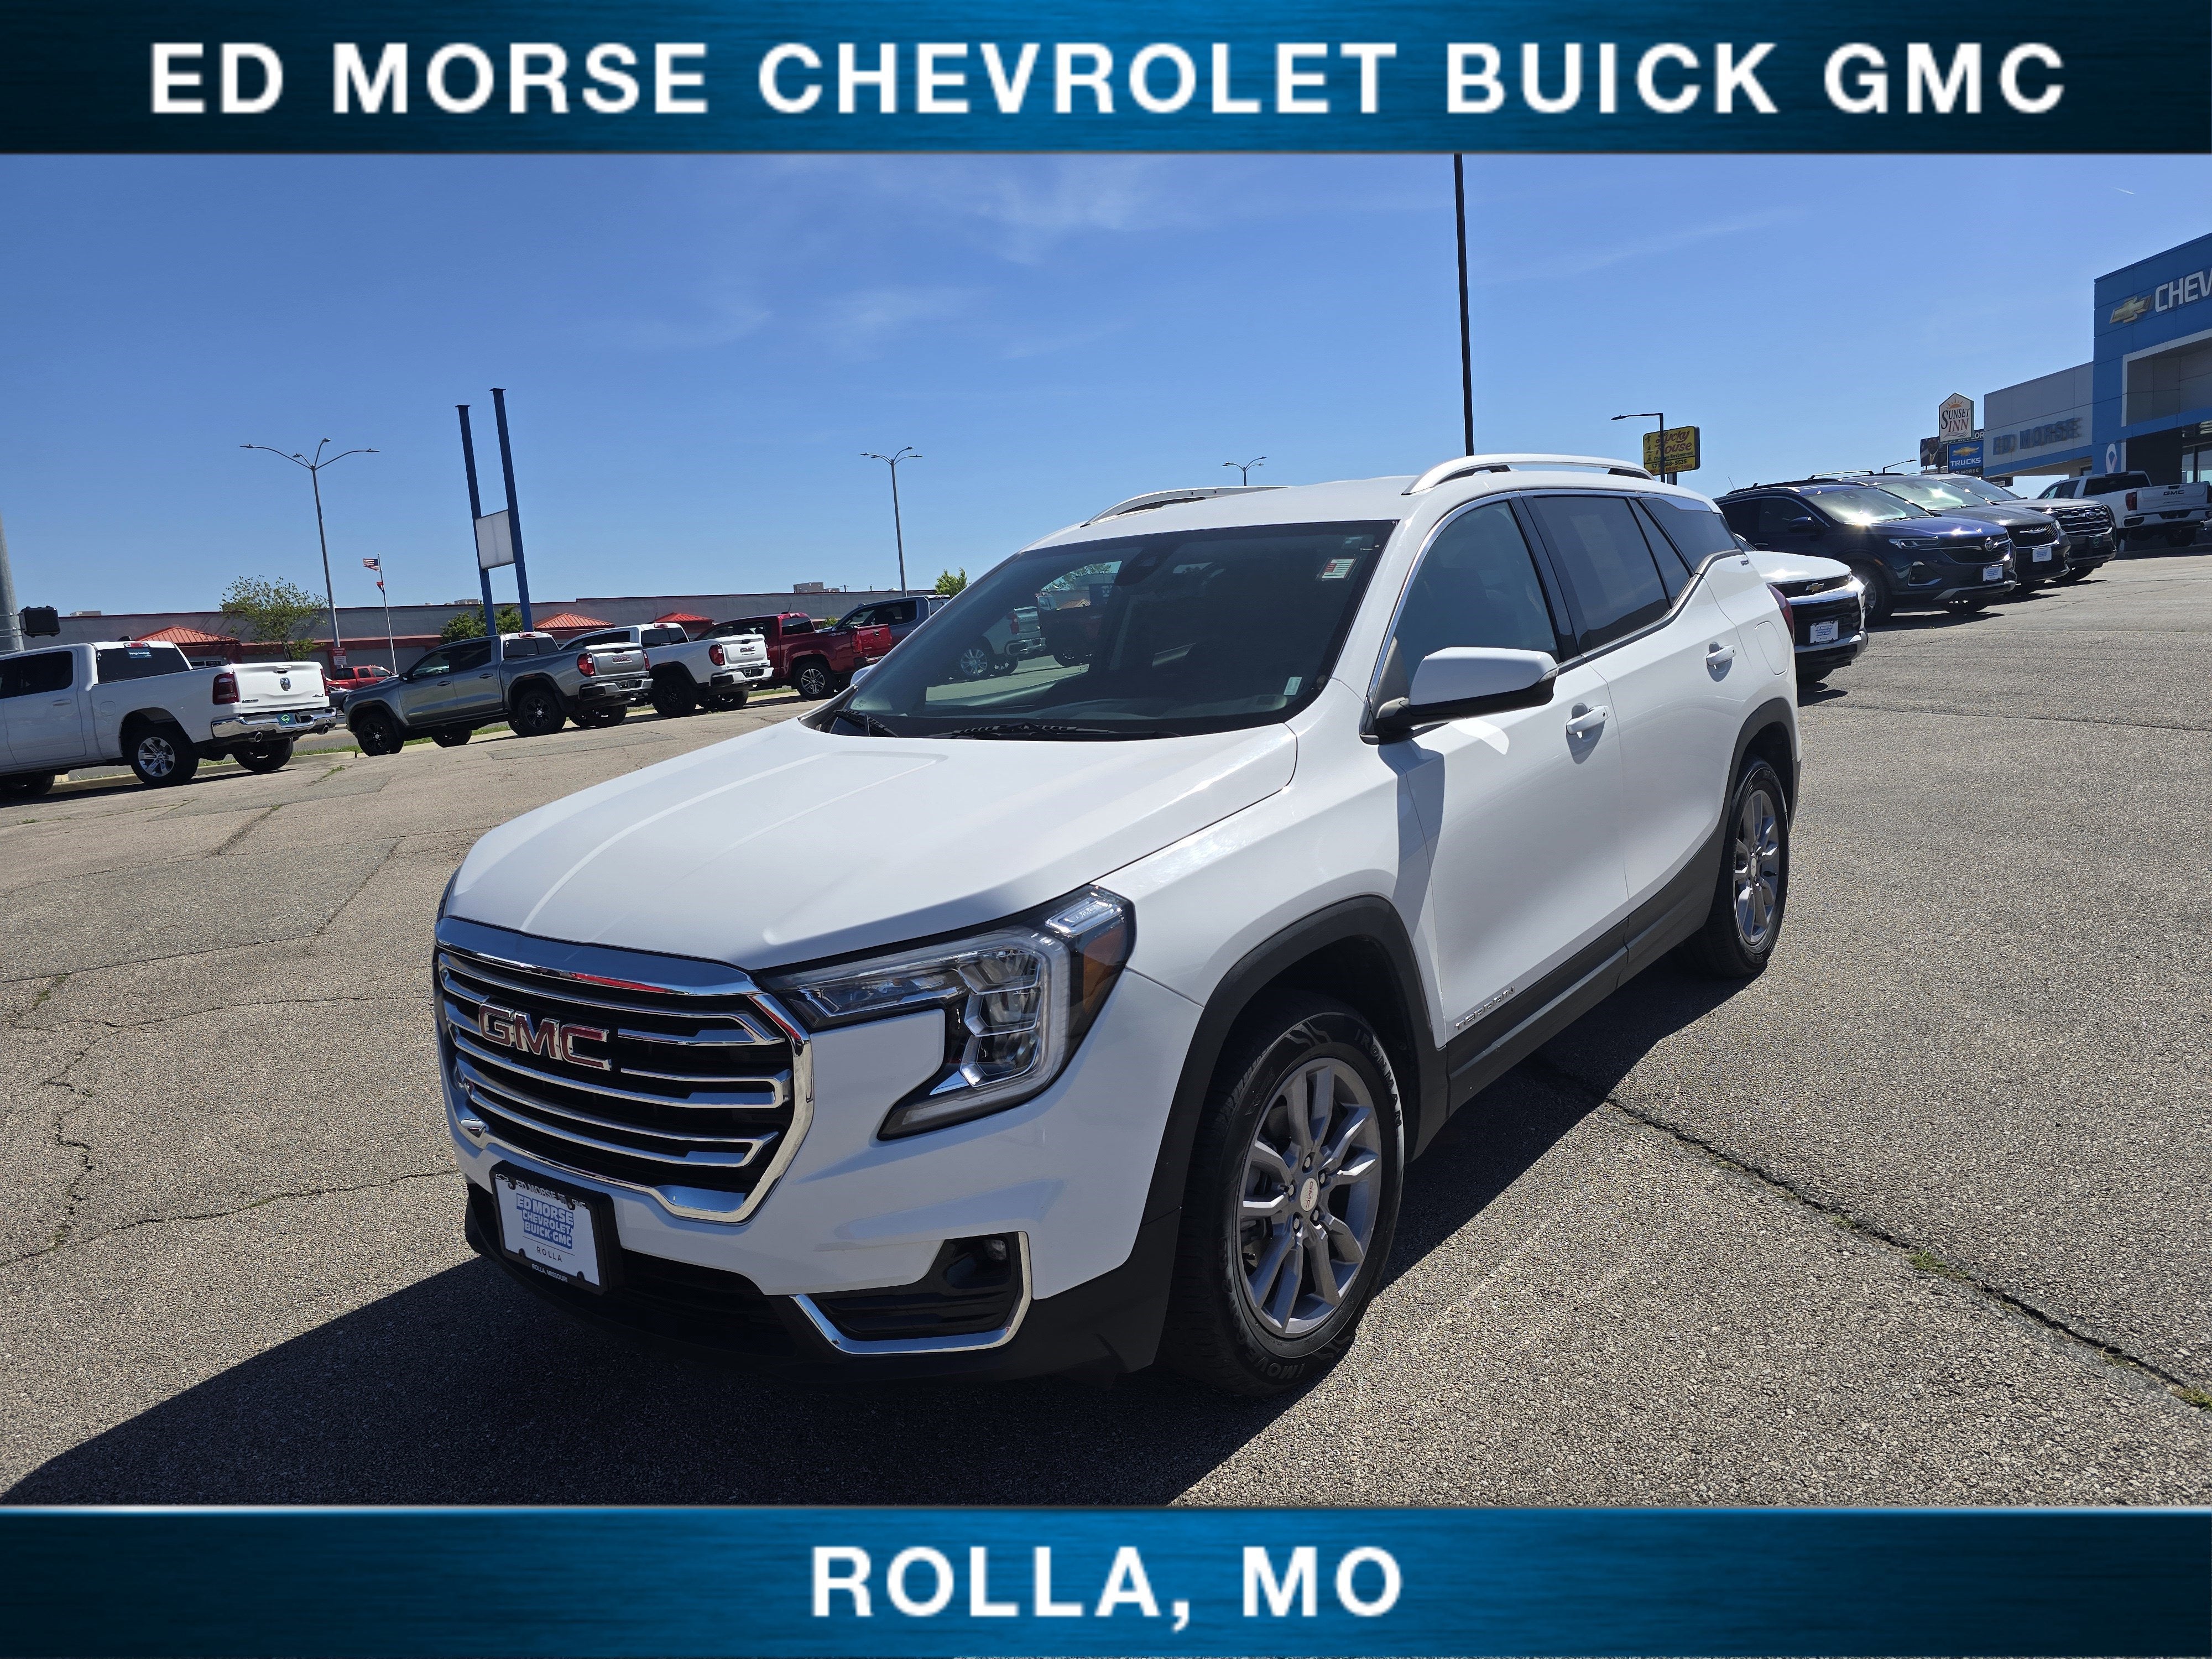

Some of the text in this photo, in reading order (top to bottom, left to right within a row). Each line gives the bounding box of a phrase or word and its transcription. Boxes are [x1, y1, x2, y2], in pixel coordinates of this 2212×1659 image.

[2155, 268, 2212, 312] CHEV
[1941, 408, 1970, 430] SUNSET
[1948, 418, 1969, 433] INN
[1992, 417, 2083, 456] ED MORSE
[1950, 457, 1981, 467] TRUCKS
[479, 1003, 612, 1071] GMC
[528, 1183, 557, 1200] MORSE
[1305, 1181, 1313, 1208] GMC
[517, 1194, 573, 1225] ED MORSE
[523, 1209, 571, 1235] CHEVROLET
[536, 1246, 562, 1262] ROLLA
